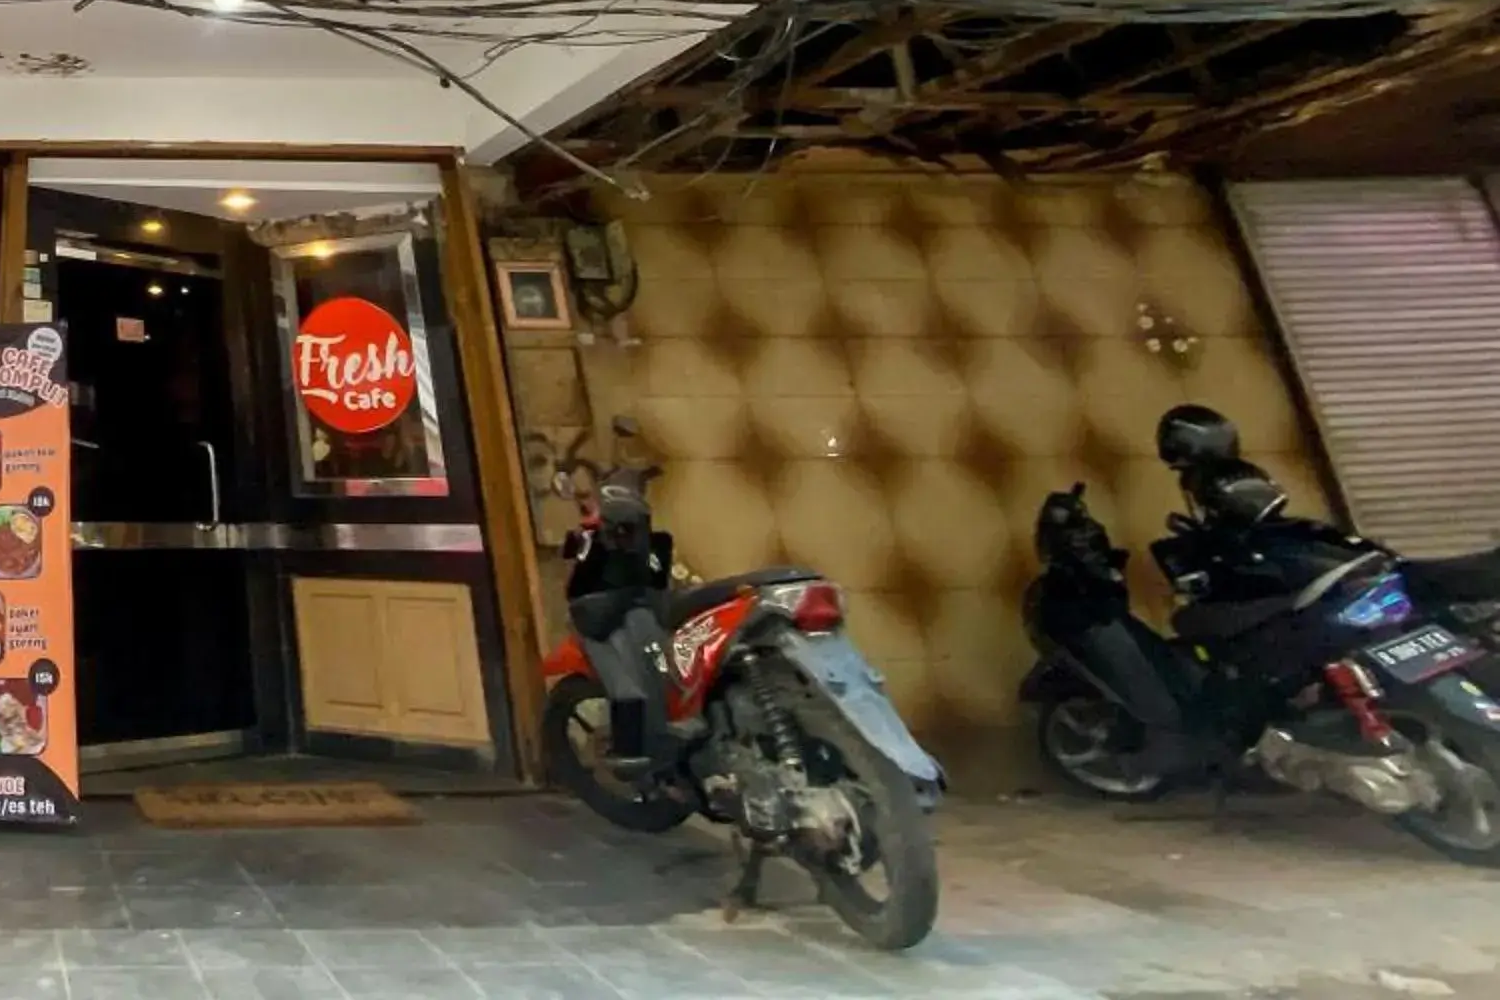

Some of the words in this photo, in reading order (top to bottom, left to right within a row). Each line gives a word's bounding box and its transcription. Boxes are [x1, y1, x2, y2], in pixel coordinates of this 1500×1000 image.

[2, 347, 54, 377] CAFE
[296, 331, 415, 389] Fresh
[343, 387, 396, 411] Cafe
[29, 800, 56, 815] teh
